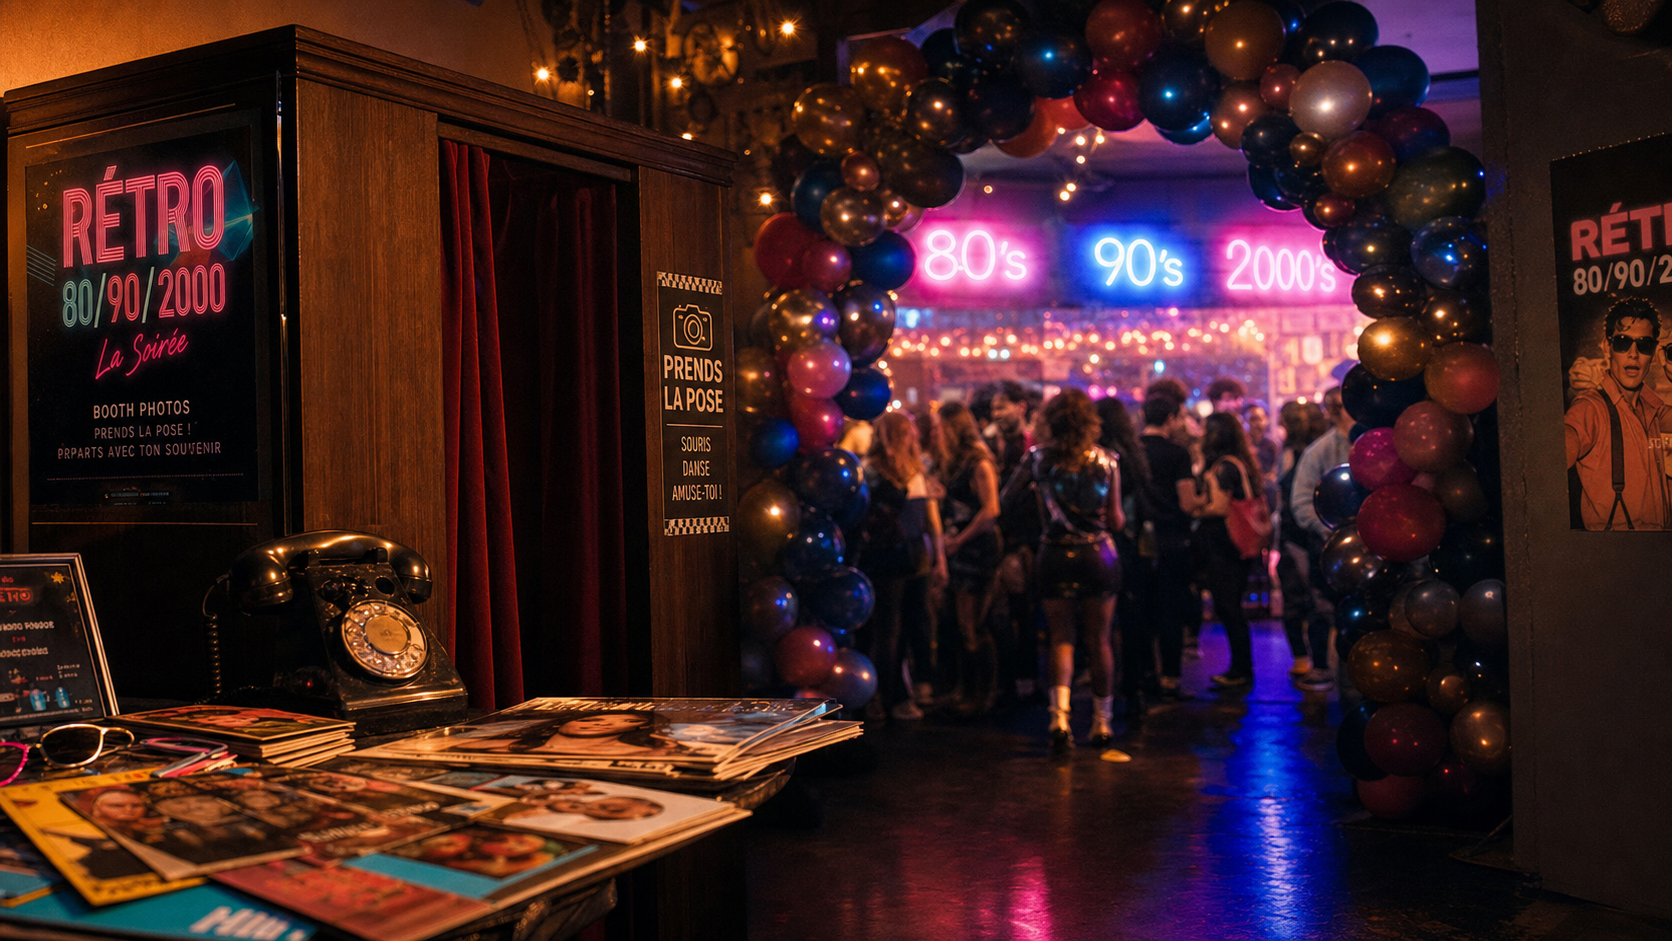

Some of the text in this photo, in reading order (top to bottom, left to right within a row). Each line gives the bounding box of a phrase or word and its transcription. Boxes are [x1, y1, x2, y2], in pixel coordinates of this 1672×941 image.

[63, 164, 224, 269] RÉTRO
[923, 229, 1027, 282] 80's
[1093, 237, 1184, 287] 90's
[1226, 239, 1336, 293] 2000's
[62, 262, 226, 329] 80/90/2000
[95, 328, 190, 381] La Soirée
[664, 354, 723, 384] PRENDS
[93, 399, 191, 420] BOOTH PHOTOS
[664, 386, 724, 413] LA POSE
[94, 425, 135, 440] PRENDS
[138, 425, 153, 438] LA
[156, 423, 184, 437] POSE
[681, 435, 711, 453] SOURIS
[107, 445, 136, 459] AVEC
[139, 444, 162, 457] TON
[682, 459, 710, 477] DANSE
